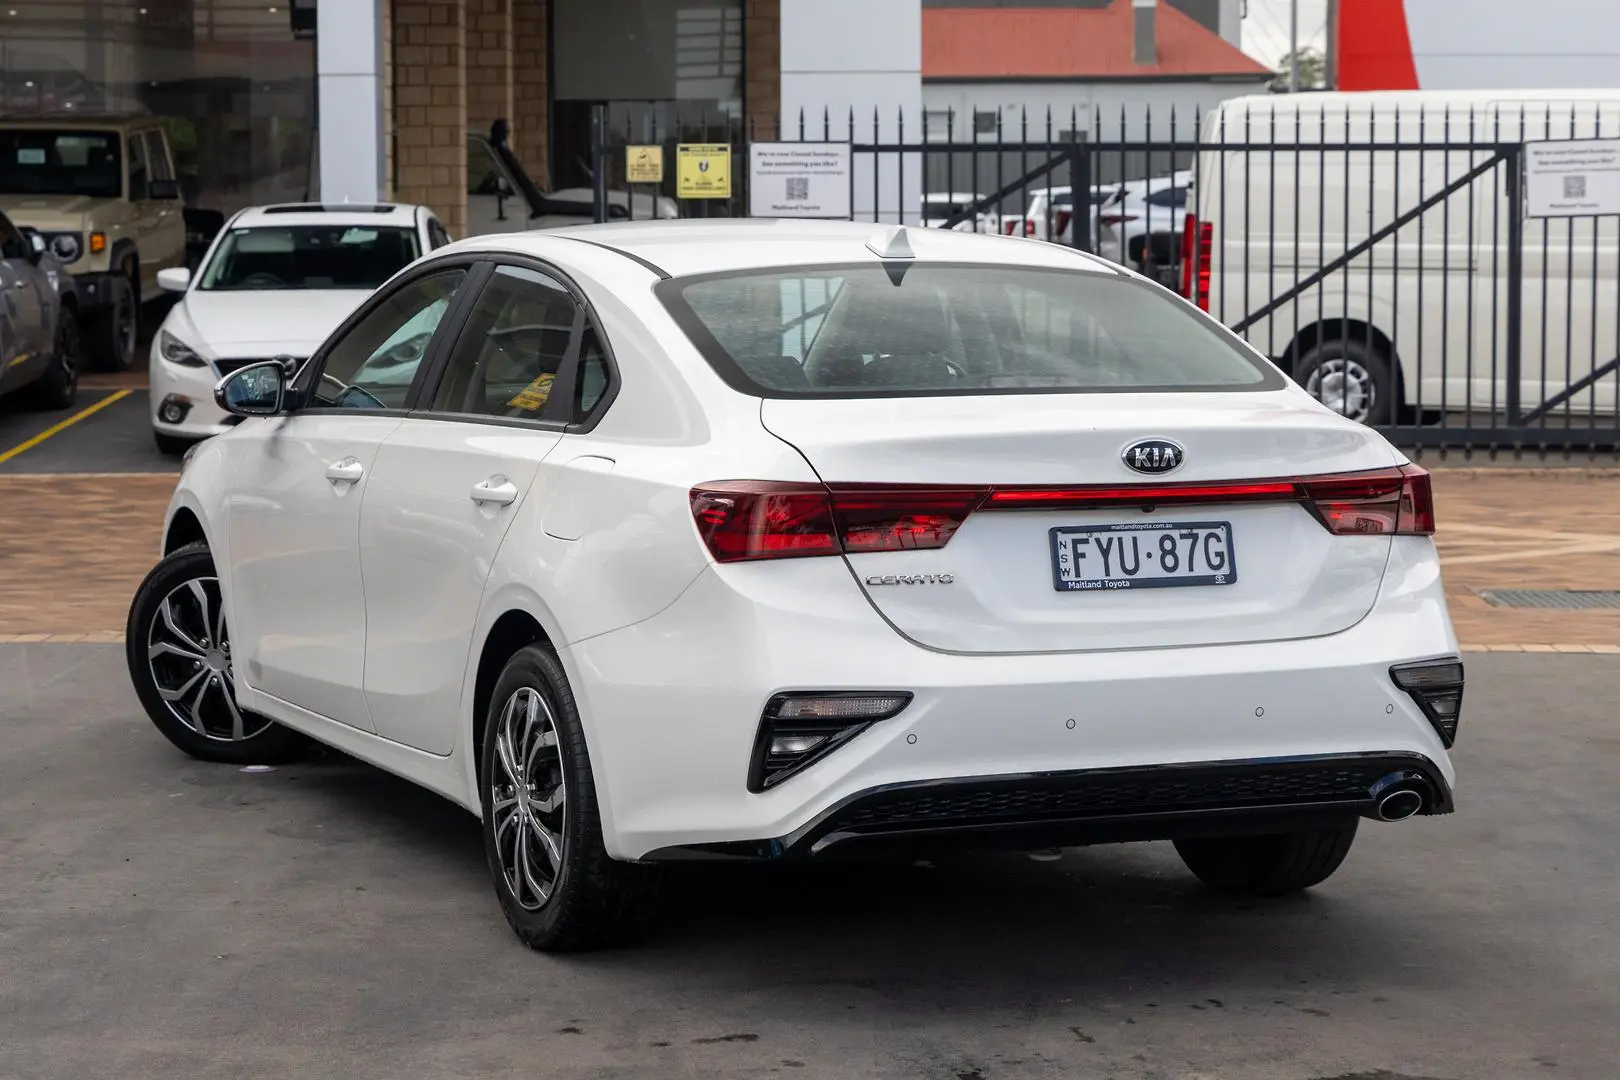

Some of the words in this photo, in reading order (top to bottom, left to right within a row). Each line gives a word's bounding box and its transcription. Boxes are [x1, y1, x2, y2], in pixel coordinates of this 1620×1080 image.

[1134, 447, 1176, 467] KIA
[1111, 523, 1173, 531] maitlandtoyota.com.au
[865, 574, 954, 586] CERATO
[1068, 580, 1102, 589] Maitland
[1103, 580, 1131, 589] Toyota
